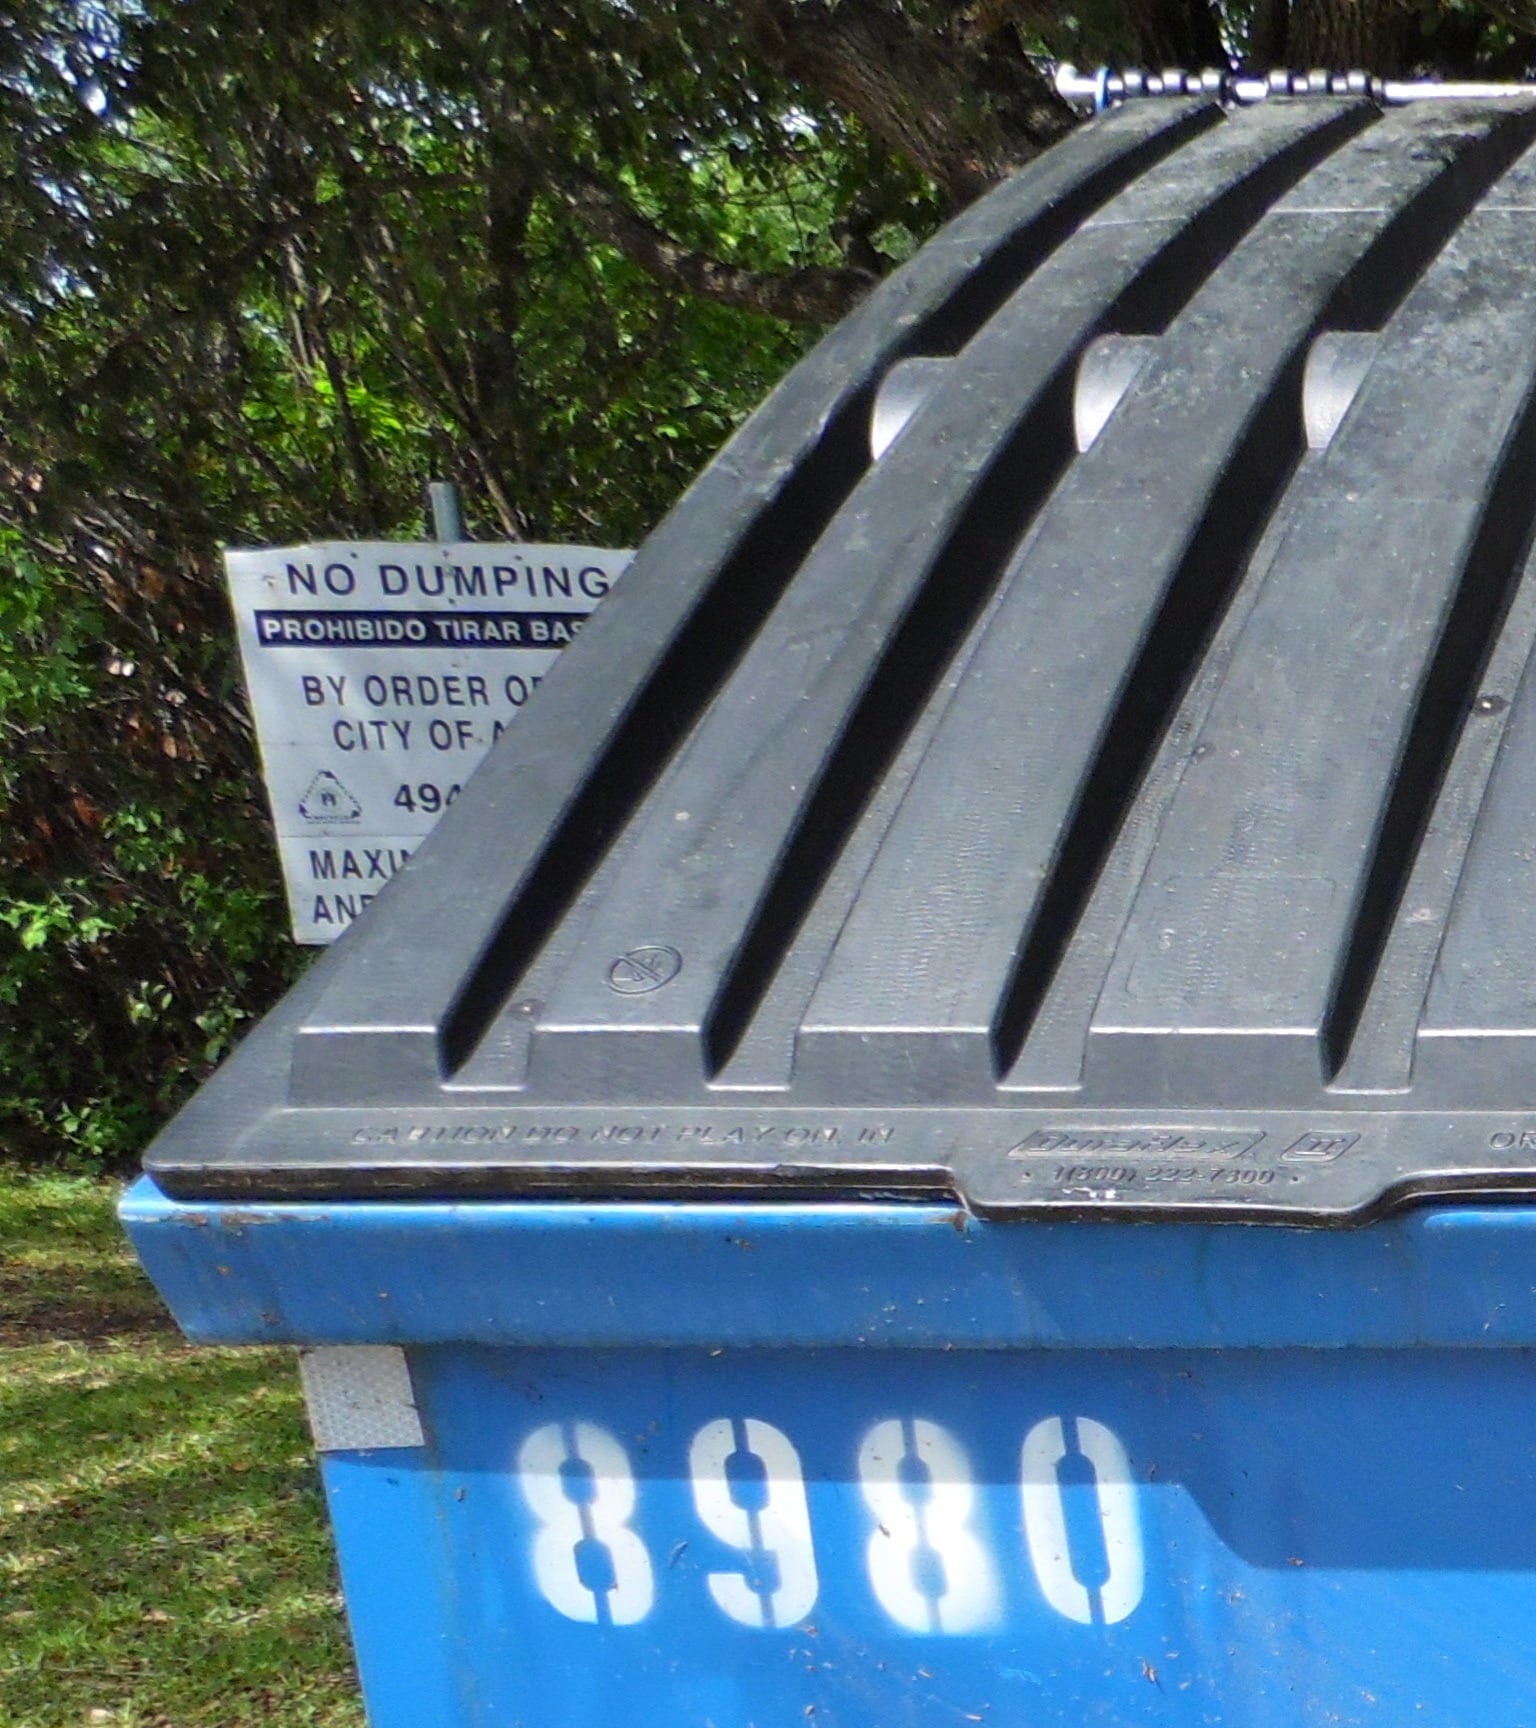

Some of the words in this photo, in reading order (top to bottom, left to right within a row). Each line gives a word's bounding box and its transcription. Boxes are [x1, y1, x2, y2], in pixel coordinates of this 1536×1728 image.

[286, 563, 357, 596] NO
[378, 564, 610, 599] DUMPING
[261, 618, 427, 641] PROHIBIDO
[434, 619, 521, 642] TIRAR
[302, 675, 347, 706] BY
[363, 674, 490, 706] ORDER
[333, 720, 412, 750] CITY
[429, 720, 474, 750] OF
[515, 1414, 1145, 1637] 8980
